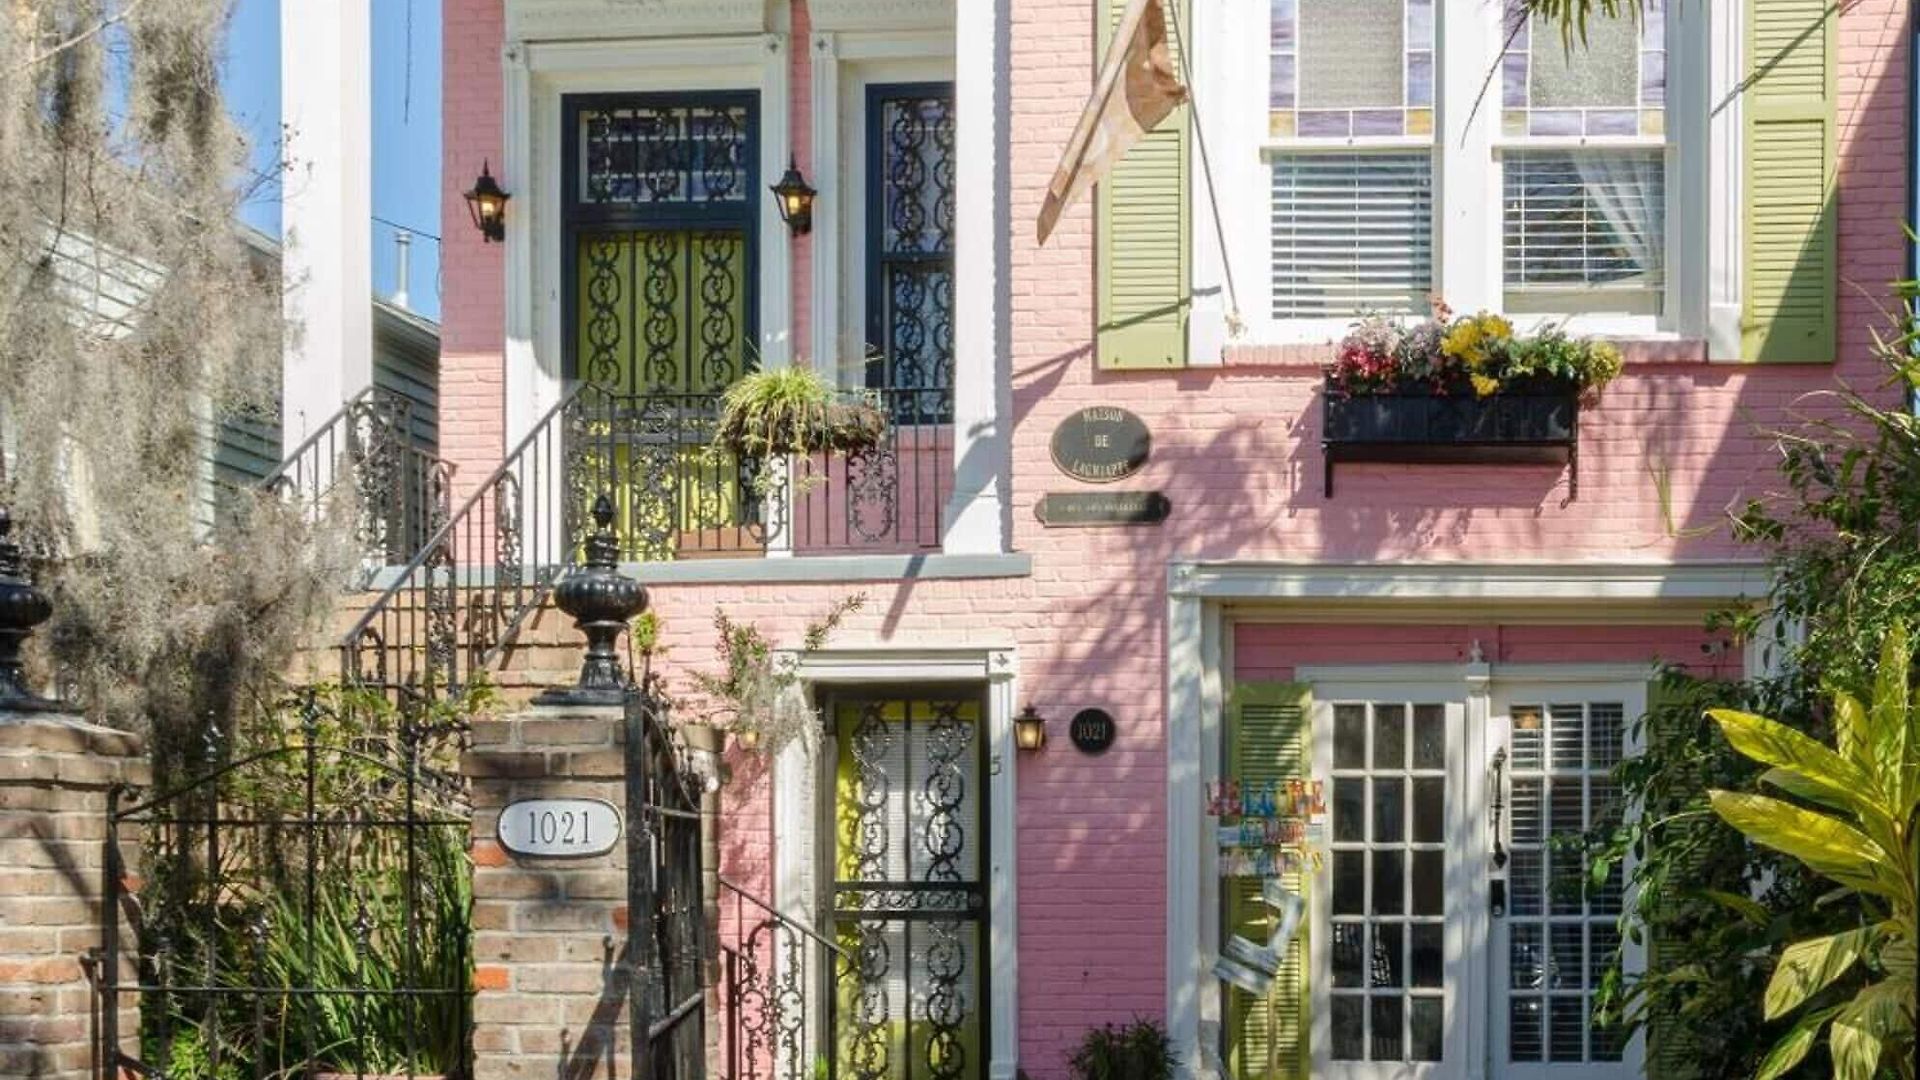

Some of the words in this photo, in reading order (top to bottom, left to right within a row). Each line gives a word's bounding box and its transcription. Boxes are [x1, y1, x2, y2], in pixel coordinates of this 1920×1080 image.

[1082, 408, 1124, 422] MAISON
[1094, 434, 1109, 448] DE
[1078, 721, 1106, 741] 1021
[529, 811, 589, 844] 1021
